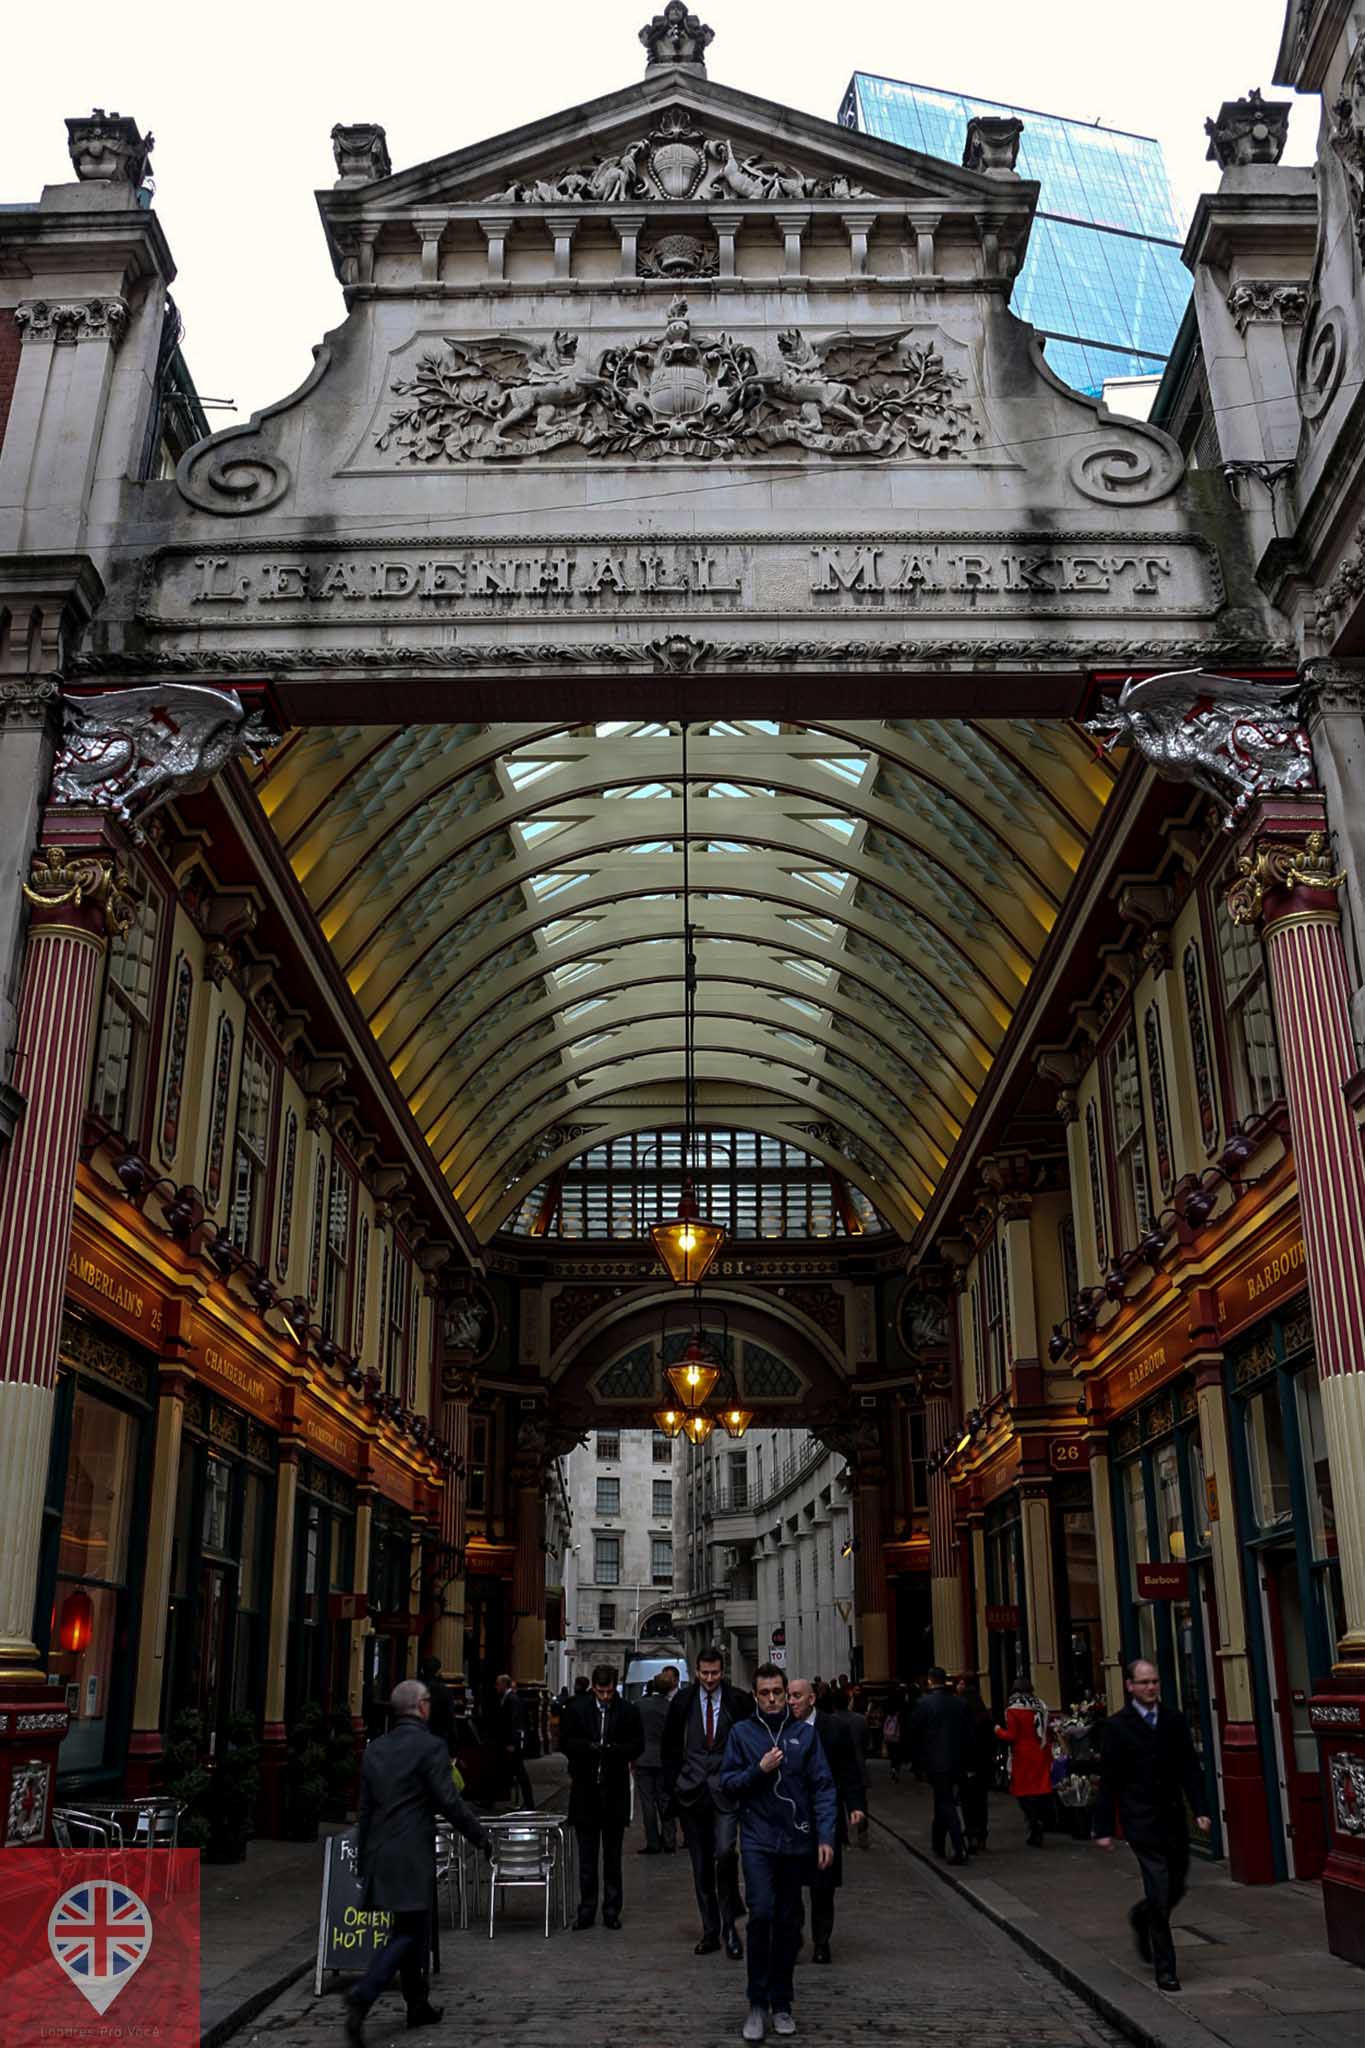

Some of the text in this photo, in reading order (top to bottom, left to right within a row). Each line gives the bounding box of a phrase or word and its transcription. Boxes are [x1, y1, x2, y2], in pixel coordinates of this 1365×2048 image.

[192, 545, 1171, 601] LEADENHALL MARKET
[710, 1260, 745, 1275] 881
[68, 1251, 143, 1318] AMBERLAIN'S
[1056, 1445, 1079, 1461] 26
[1143, 1575, 1180, 1585] Barbour
[343, 1905, 394, 1929] ORIEN
[332, 1927, 367, 1951] HOT
